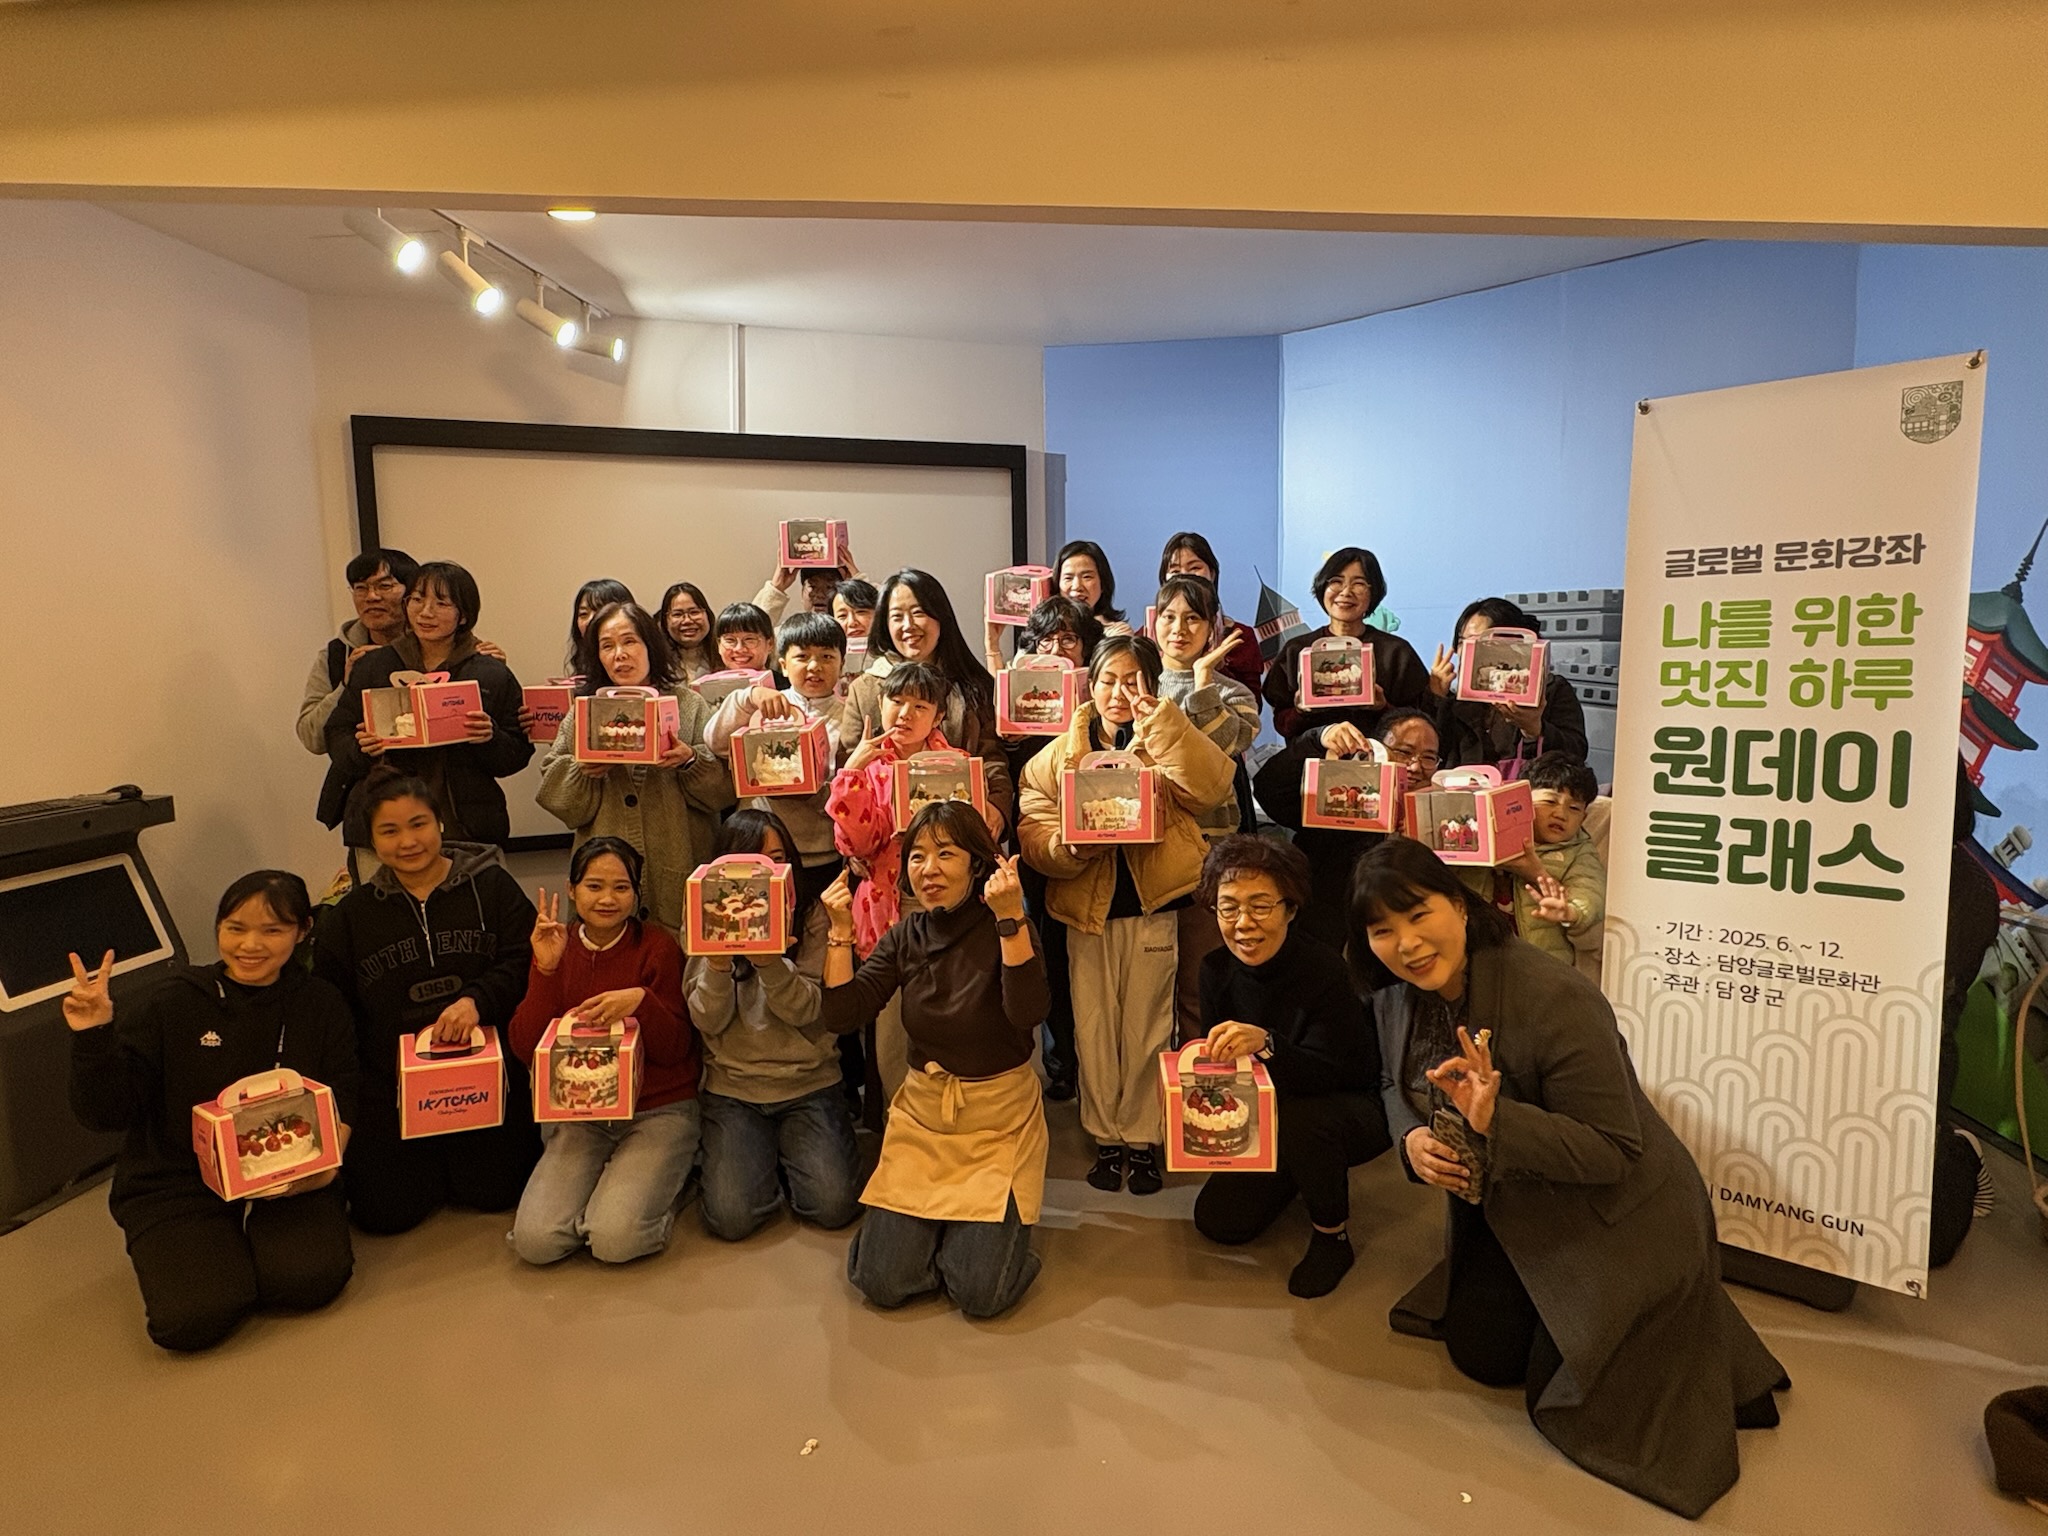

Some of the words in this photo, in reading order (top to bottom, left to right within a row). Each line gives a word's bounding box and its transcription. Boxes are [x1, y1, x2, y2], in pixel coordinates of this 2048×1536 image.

[1664, 544, 1763, 578] 글로벌
[1773, 533, 1926, 573] 문화강좌
[1662, 599, 1773, 650] 나를
[1791, 592, 1924, 648] 위한
[1659, 658, 1769, 709] 멋진
[1789, 658, 1915, 711] 하루
[1649, 725, 1913, 809] 원데이
[1645, 810, 1906, 902] 클래스
[1665, 921, 1703, 942] 기간
[1718, 928, 1770, 950] 2025.
[1776, 936, 1793, 953] 6.
[1818, 941, 1844, 960] 12.
[1662, 972, 1700, 995] 주관
[1664, 946, 1702, 967] 장소
[1717, 954, 1882, 995] 담양글로벌문화관
[1720, 1187, 1815, 1224] DAMYANG
[1821, 1214, 1865, 1237] GUN
